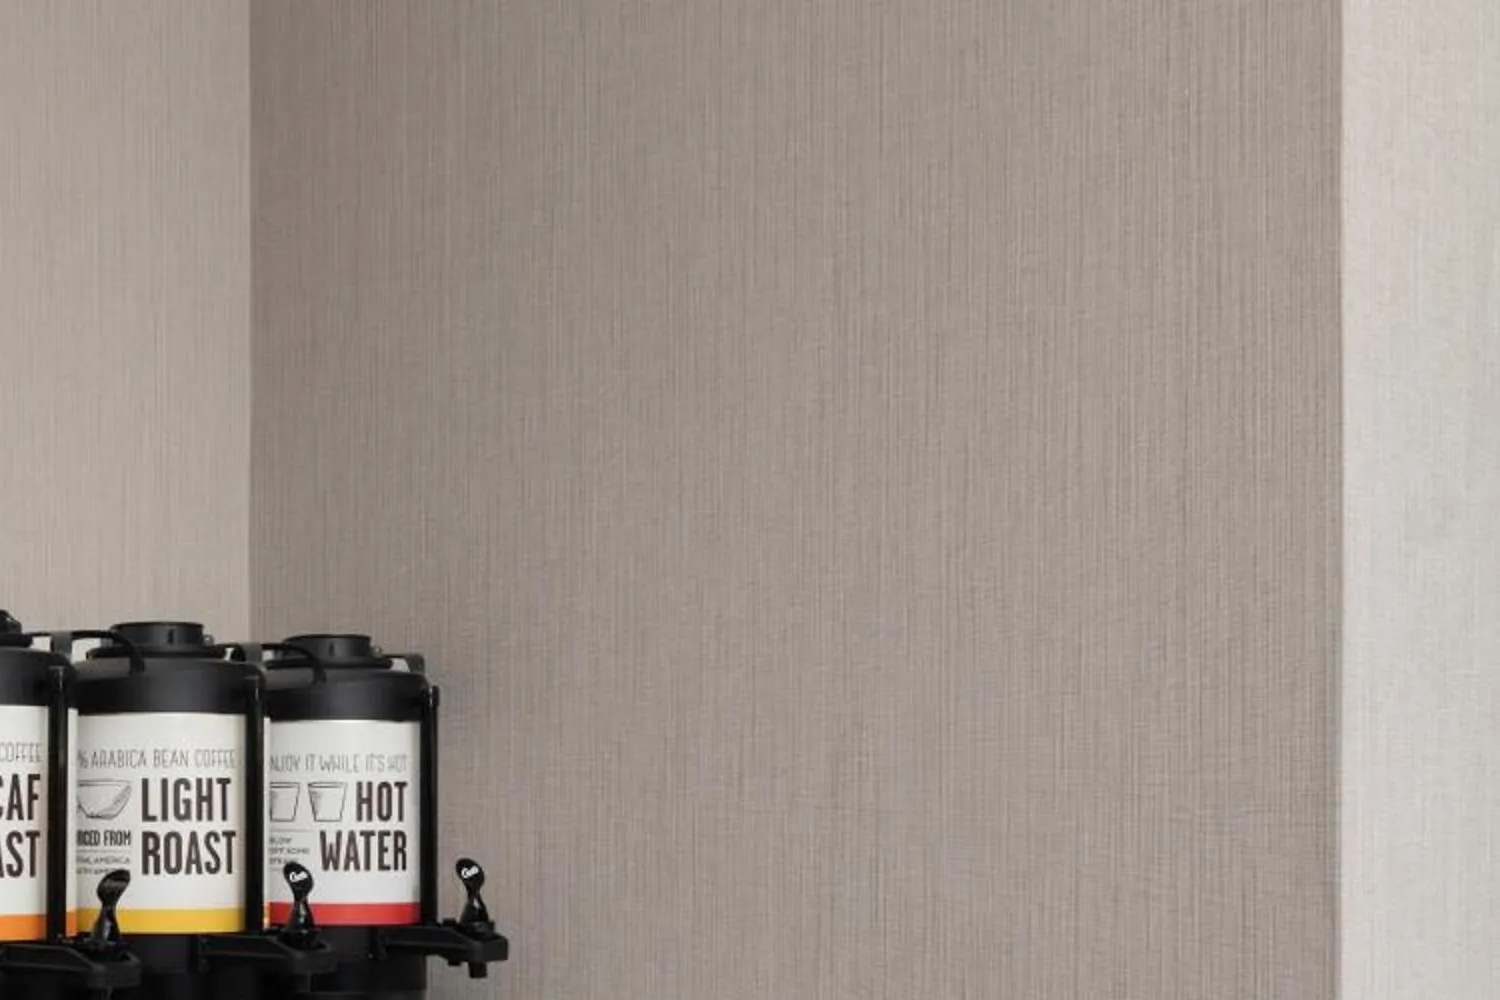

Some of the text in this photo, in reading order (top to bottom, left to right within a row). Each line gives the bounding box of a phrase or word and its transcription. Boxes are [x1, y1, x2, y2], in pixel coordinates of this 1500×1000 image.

[91, 750, 148, 769] ARABICA
[153, 750, 190, 769] BEAN
[269, 753, 300, 772] NJOY
[304, 753, 316, 772] IT
[319, 753, 360, 772] WHILE
[141, 778, 232, 823] LIGHT
[355, 781, 409, 823] HOT
[103, 829, 132, 847] FROM
[141, 831, 237, 875] ROAST
[319, 829, 408, 873] WATER
